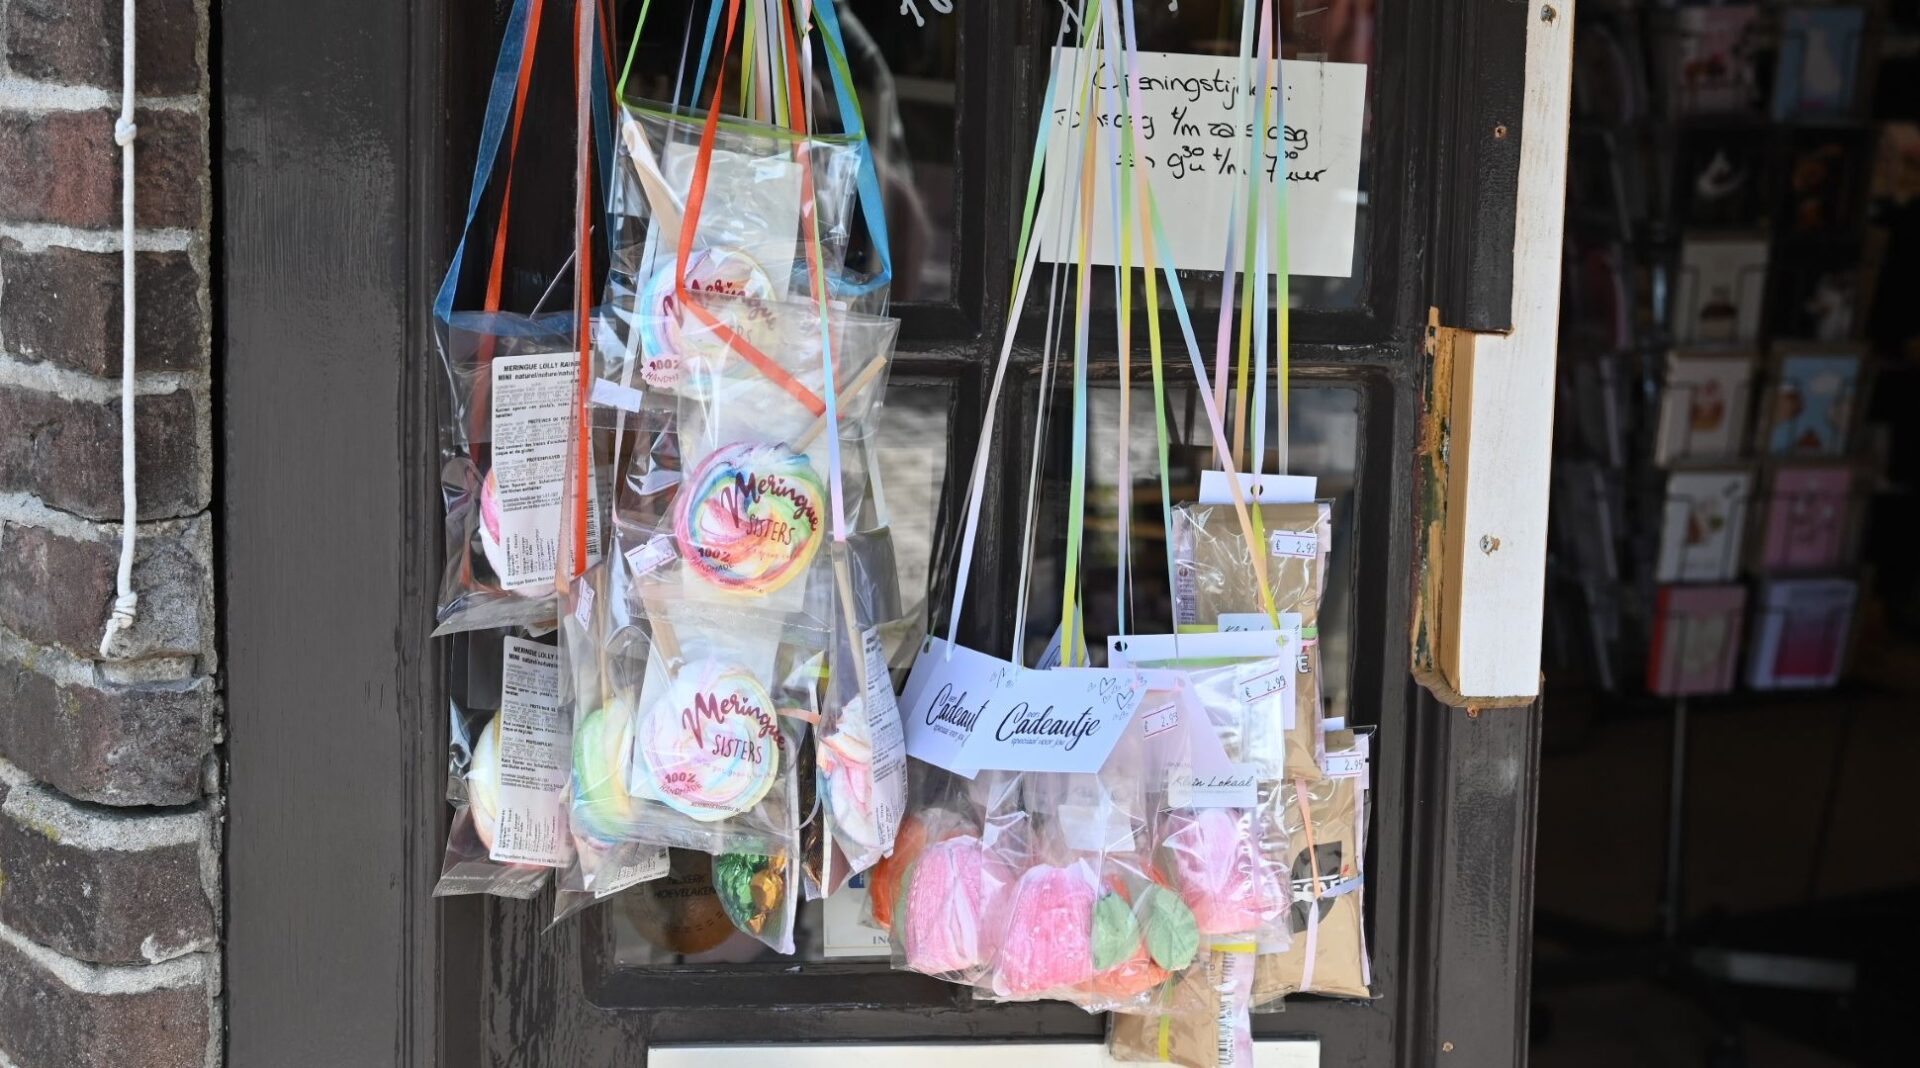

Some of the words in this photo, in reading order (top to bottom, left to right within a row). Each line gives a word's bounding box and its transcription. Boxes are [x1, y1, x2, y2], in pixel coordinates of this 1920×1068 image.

[1171, 106, 1201, 137] t/m
[503, 363, 538, 372] MERINGUE
[539, 362, 558, 370] LOLLY
[721, 472, 818, 532] Meringue
[746, 514, 796, 545] SISTERS
[698, 547, 731, 562] 100%
[682, 692, 785, 750] Meringue
[926, 683, 990, 740] Cadeaut
[996, 702, 1101, 751] Cadeautje
[712, 734, 762, 765] SISTERS
[665, 771, 697, 784] 100%
[1208, 775, 1254, 788] Lokaal
